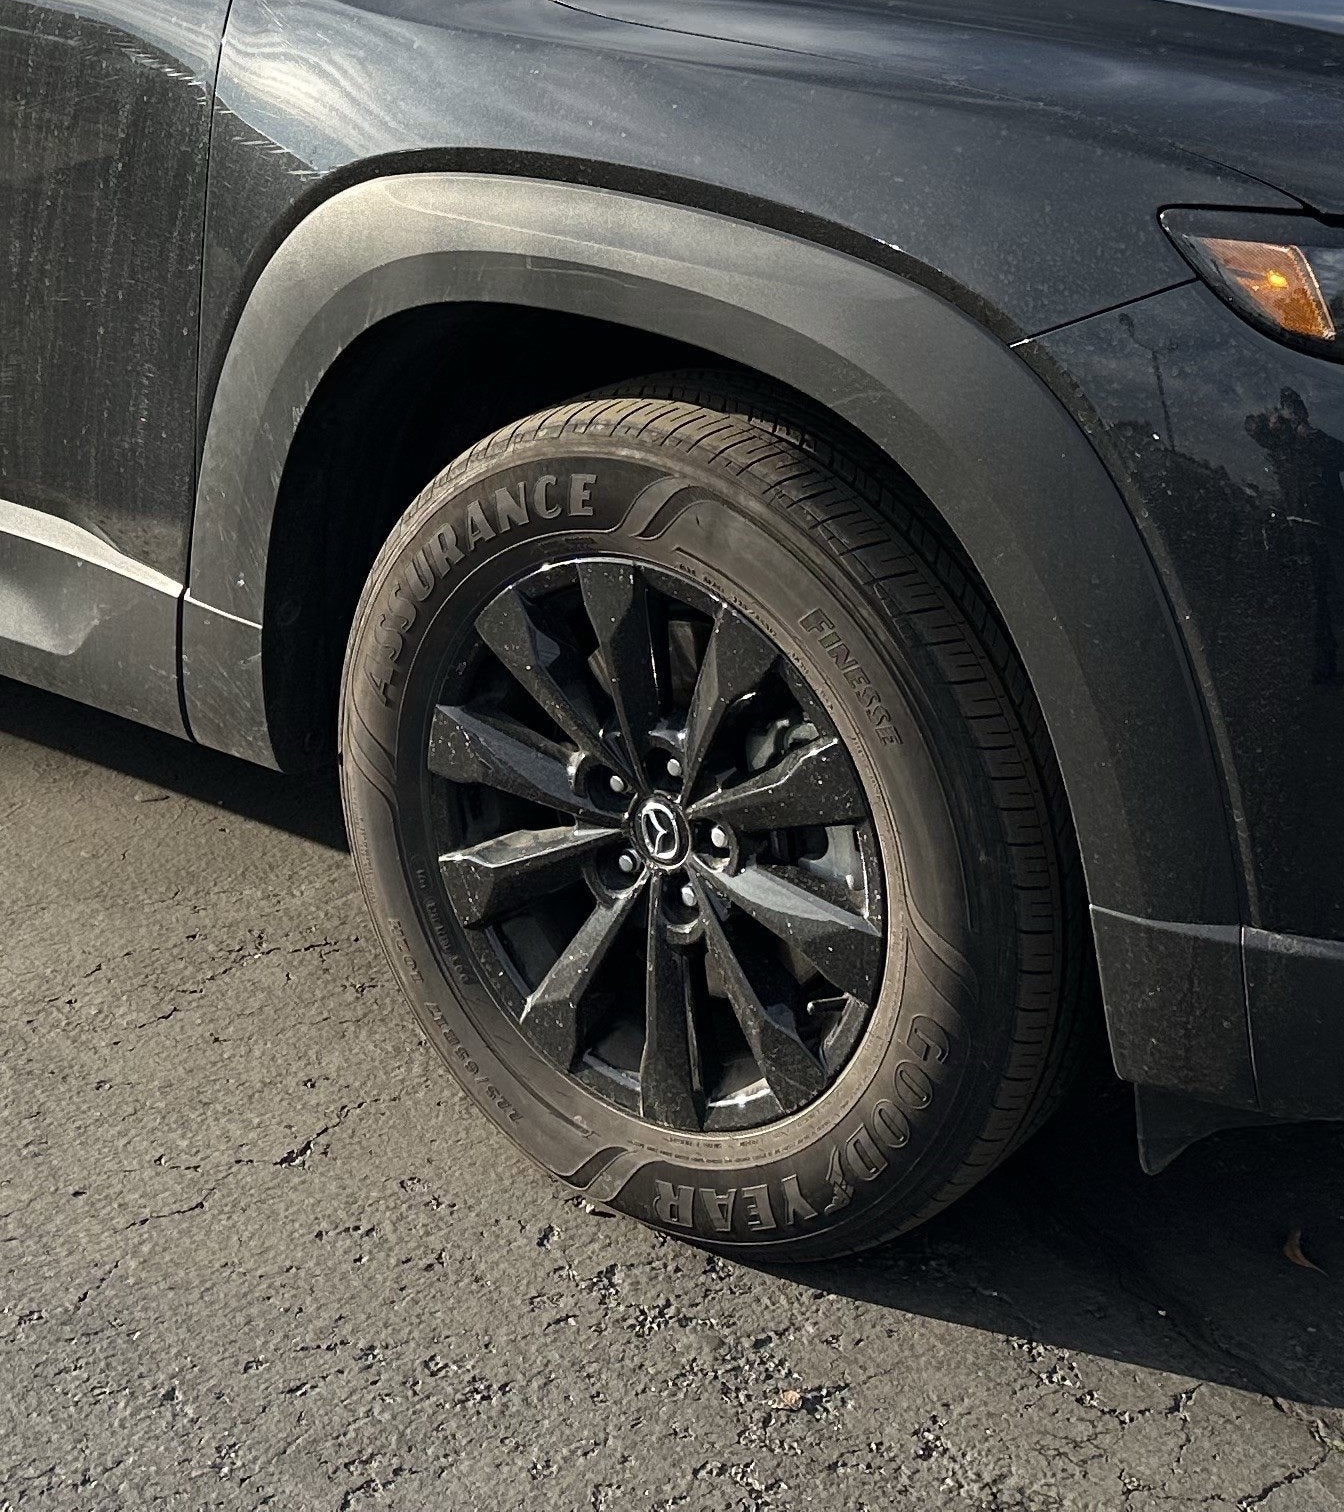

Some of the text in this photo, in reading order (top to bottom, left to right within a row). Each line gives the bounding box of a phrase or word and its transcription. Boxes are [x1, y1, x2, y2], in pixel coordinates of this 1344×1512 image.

[364, 473, 598, 708] ASSURANCE
[798, 607, 903, 746] FINESSE
[652, 1013, 951, 1233] GOODYEAR
